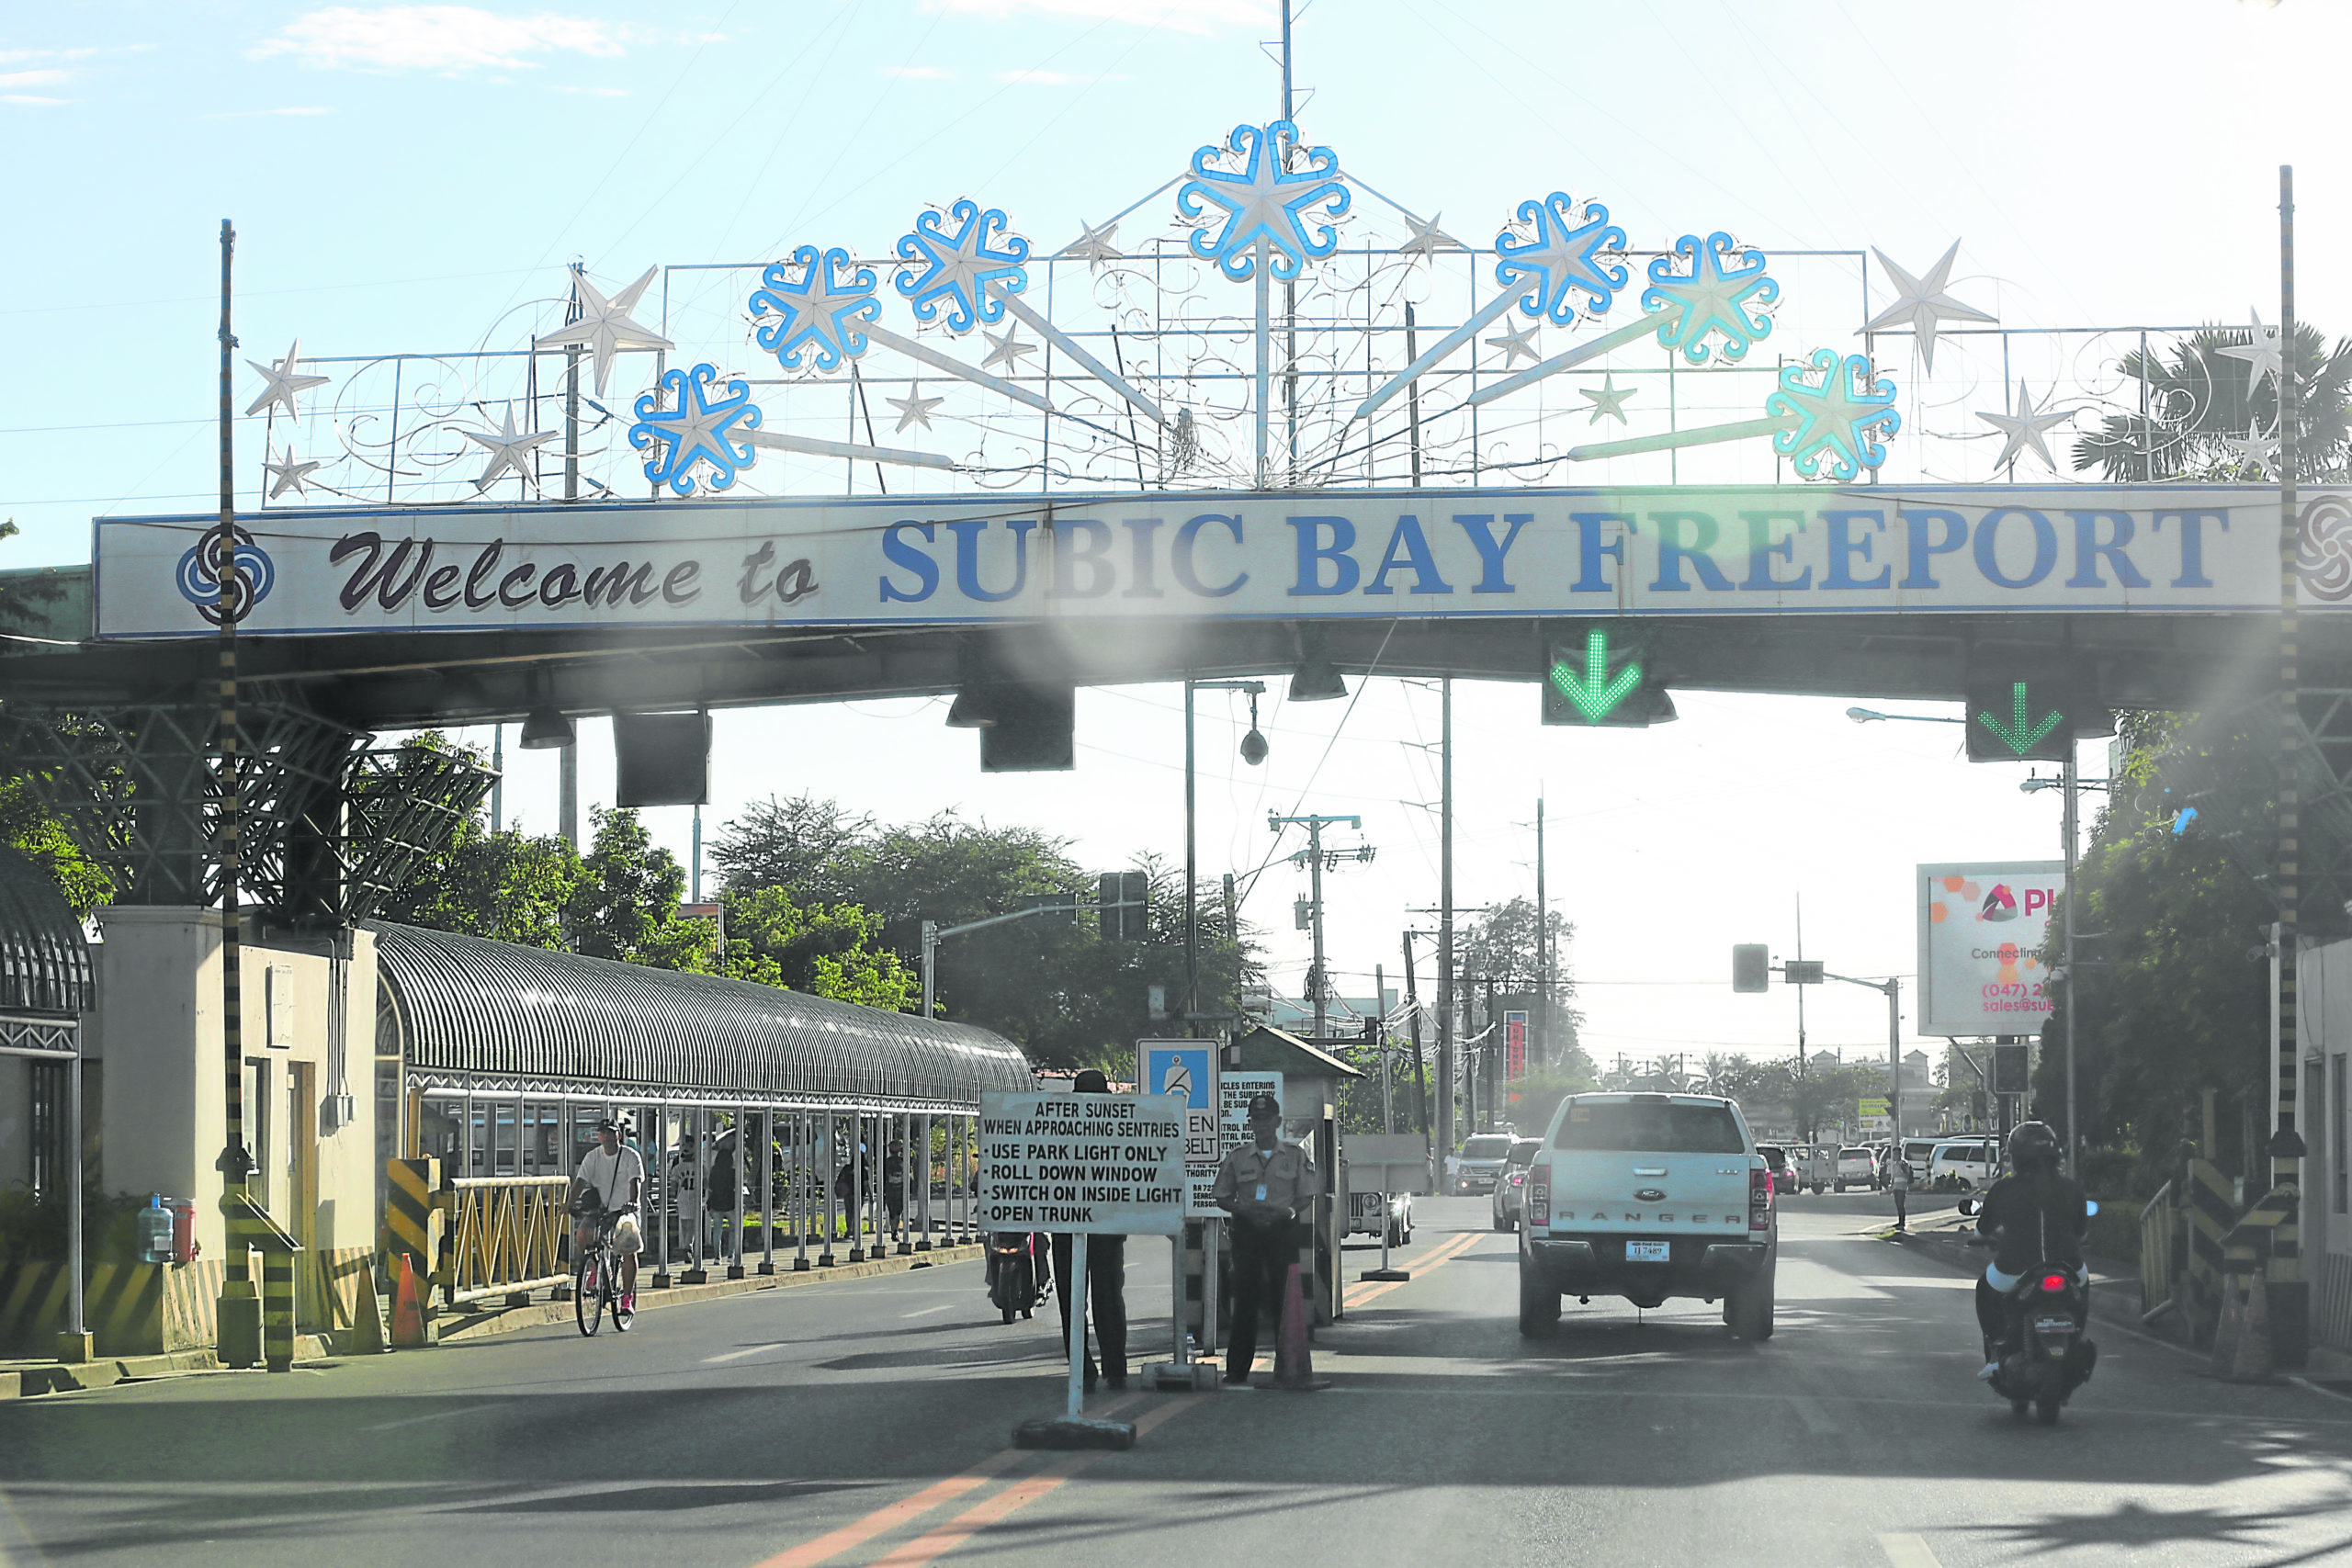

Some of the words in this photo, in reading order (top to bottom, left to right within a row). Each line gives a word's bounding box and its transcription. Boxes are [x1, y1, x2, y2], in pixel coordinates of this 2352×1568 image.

[330, 531, 700, 614] Welcome
[737, 540, 820, 604] to
[879, 513, 1250, 604] SUBIC
[1286, 513, 1535, 597] BAY
[1569, 505, 2230, 594] FREEPORT
[1982, 983, 2028, 998] (047)
[1220, 1081, 1240, 1090] ICLES
[1241, 1081, 1275, 1089] ENTERING
[1223, 1090, 1238, 1100] THE
[1035, 1101, 1080, 1118] AFTER
[1085, 1102, 1136, 1119] SUNSET
[1233, 1100, 1249, 1109] SUB
[984, 1119, 1022, 1135] WHEN
[1024, 1120, 1114, 1137] APPROACHING
[1117, 1122, 1180, 1138] SENTRIES
[1189, 1115, 1214, 1133] EN
[1221, 1122, 1240, 1132] TROL
[1220, 1132, 1239, 1141] NTAL
[1241, 1132, 1255, 1141] AGE
[991, 1143, 1021, 1159] USE
[1027, 1144, 1069, 1160] PARK
[1074, 1145, 1120, 1161] LIGHT
[1125, 1145, 1168, 1162] ONLY
[1185, 1137, 1216, 1155] BELT
[991, 1164, 1034, 1180] ROLL
[1039, 1165, 1086, 1181] DOWN
[1091, 1166, 1158, 1182] WINDOW
[1185, 1168, 1217, 1178] THORITY
[991, 1184, 1049, 1201] SWITCH
[1053, 1186, 1076, 1201] ON
[1082, 1186, 1130, 1202] INSIDE
[1136, 1187, 1182, 1203] LIGHT
[990, 1205, 1034, 1222] OPEN
[1038, 1206, 1093, 1223] TRUNK
[1558, 1211, 1741, 1224] RANGER
